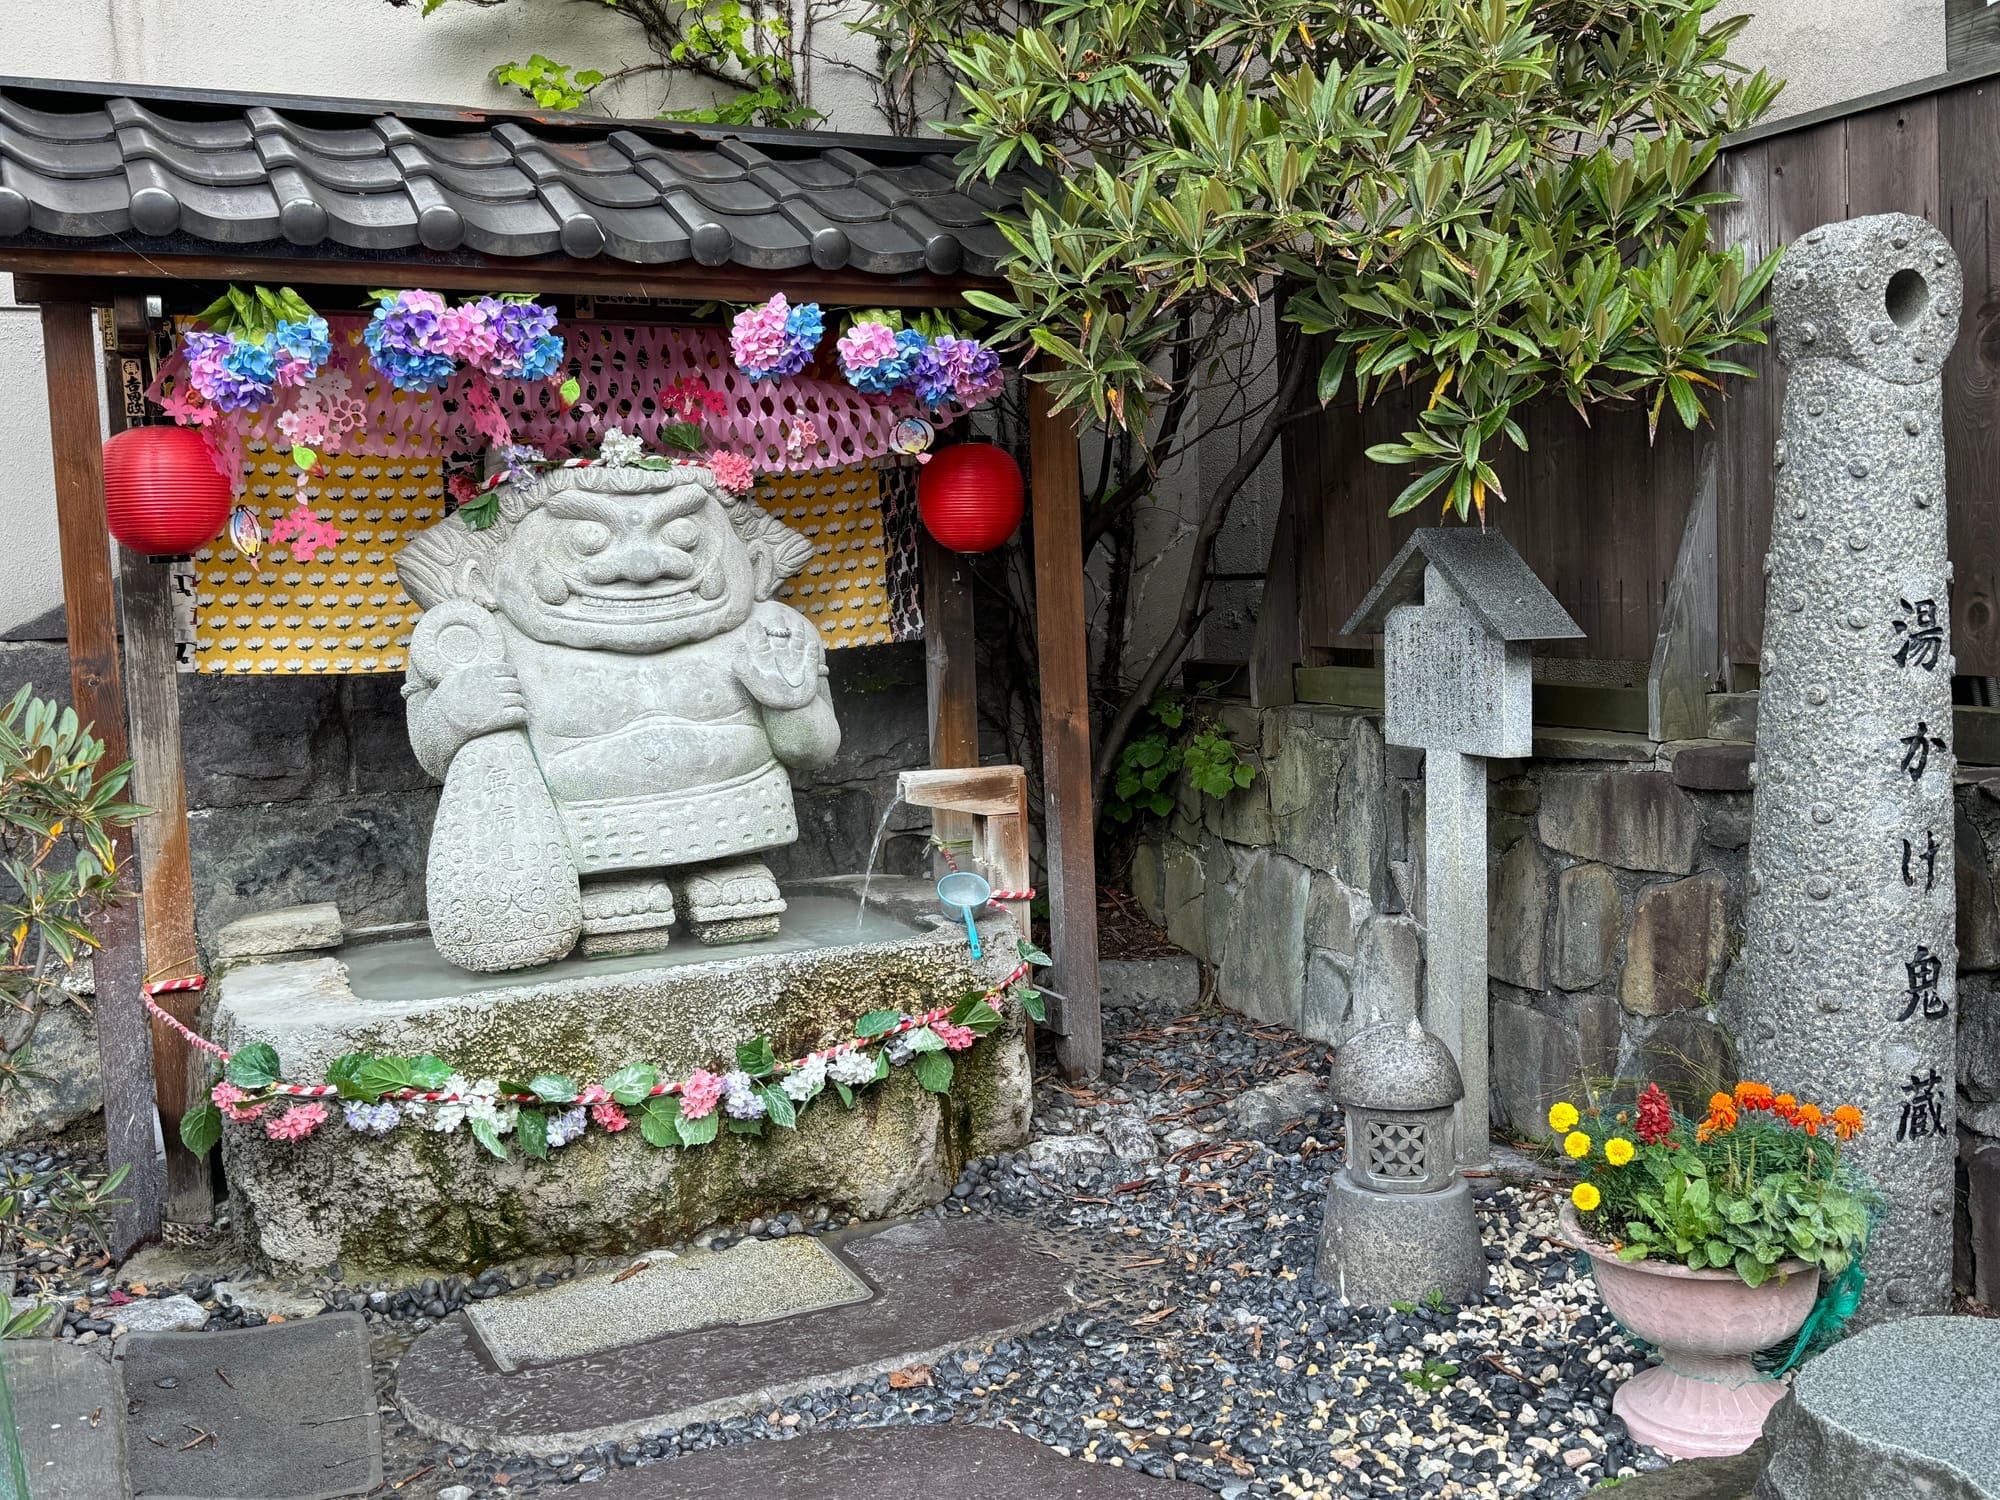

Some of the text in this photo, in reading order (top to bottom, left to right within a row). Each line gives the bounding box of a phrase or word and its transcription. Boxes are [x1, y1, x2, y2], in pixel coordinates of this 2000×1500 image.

[483, 766, 532, 913] 無病息災
[1892, 598, 1950, 1142] 湯かけ鬼蔵
